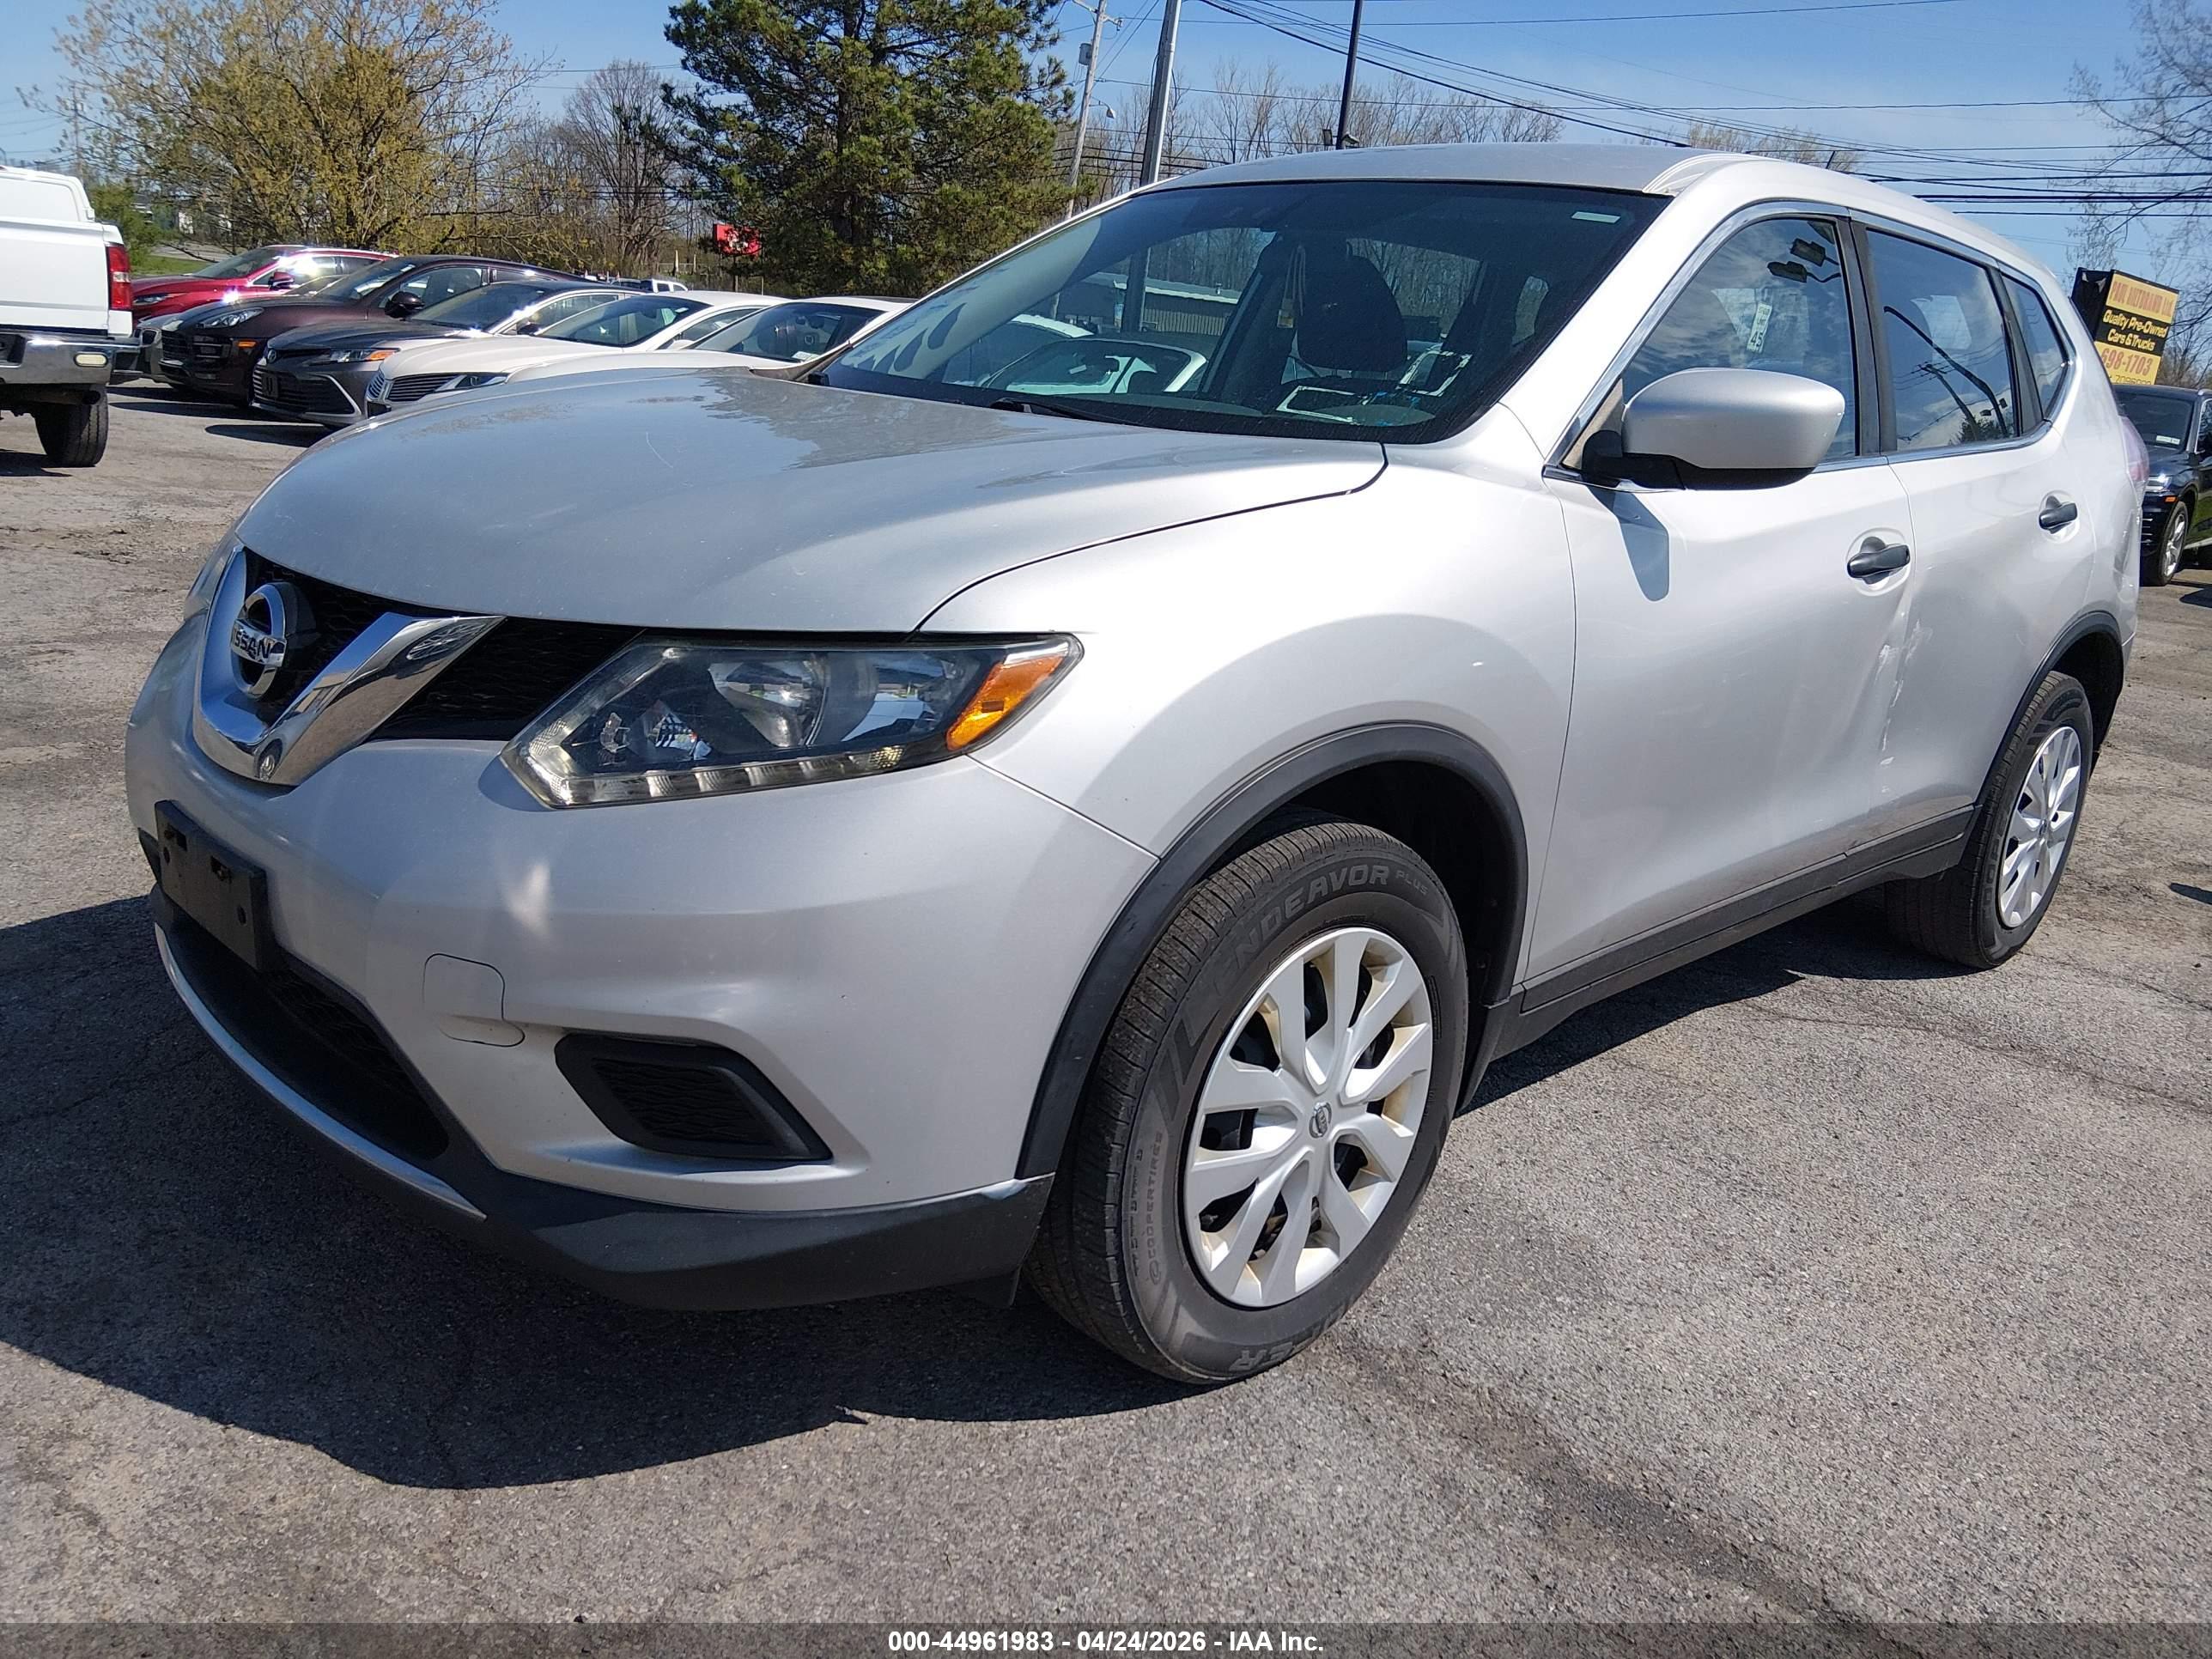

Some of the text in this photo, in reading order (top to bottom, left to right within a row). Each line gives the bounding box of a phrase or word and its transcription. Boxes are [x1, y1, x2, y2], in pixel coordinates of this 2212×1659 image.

[2102, 309, 2169, 338] Quality Pre-Owned
[2107, 328, 2127, 344] Cars
[1395, 869, 1429, 896] PLUS
